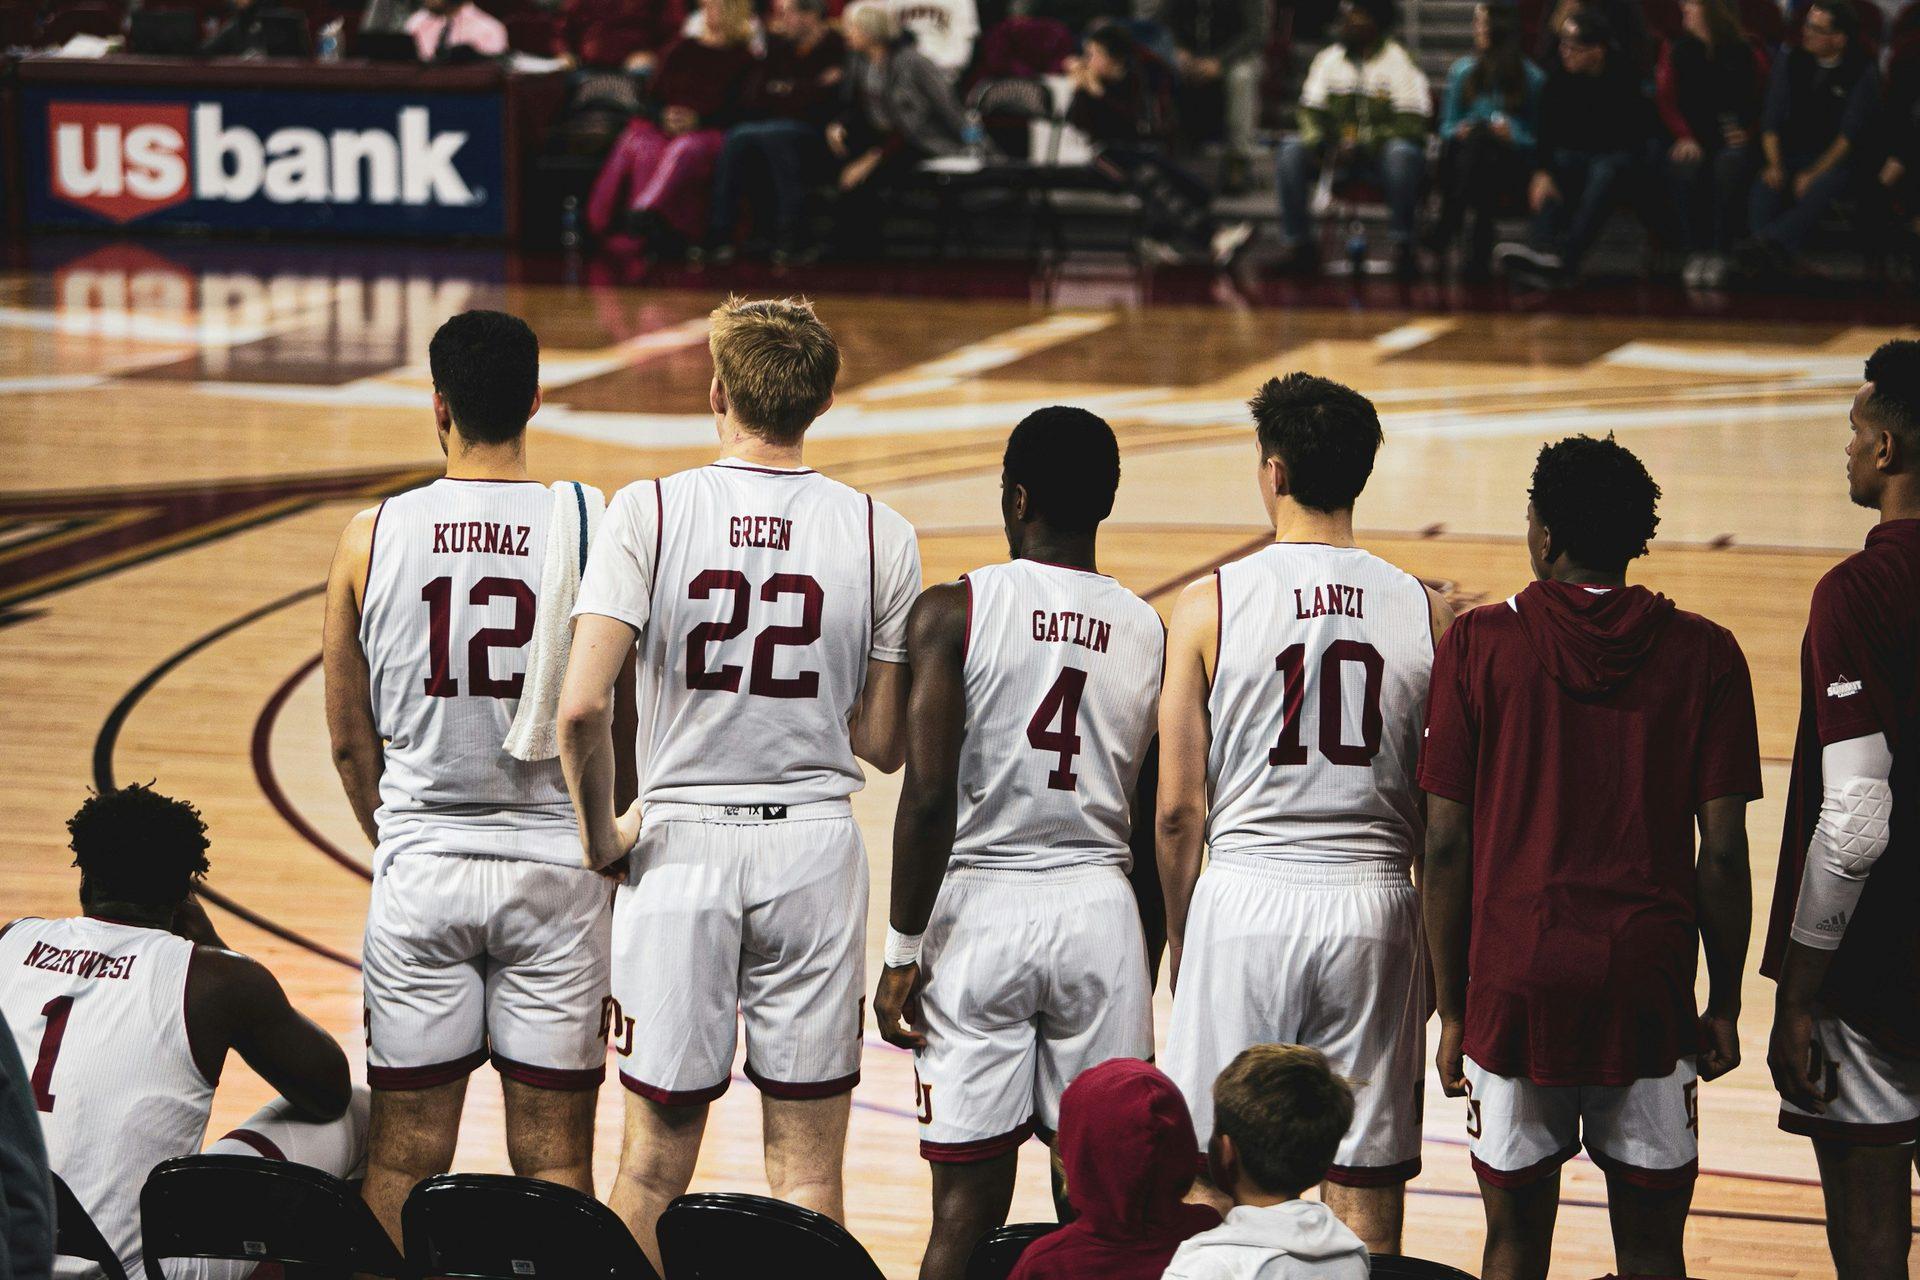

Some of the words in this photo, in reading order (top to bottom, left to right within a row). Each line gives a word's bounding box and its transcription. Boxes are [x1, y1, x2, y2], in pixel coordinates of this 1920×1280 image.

[433, 522, 531, 557] KURNAZ
[729, 515, 793, 552] GREEN
[421, 576, 537, 699] 12
[686, 569, 825, 699] 22
[1032, 609, 1112, 654] GATLIN
[1294, 584, 1364, 620] LANZI
[1026, 666, 1088, 792] 4
[1268, 639, 1385, 768] 10
[24, 941, 137, 980] NZEKWESI
[31, 995, 76, 1114] 1
